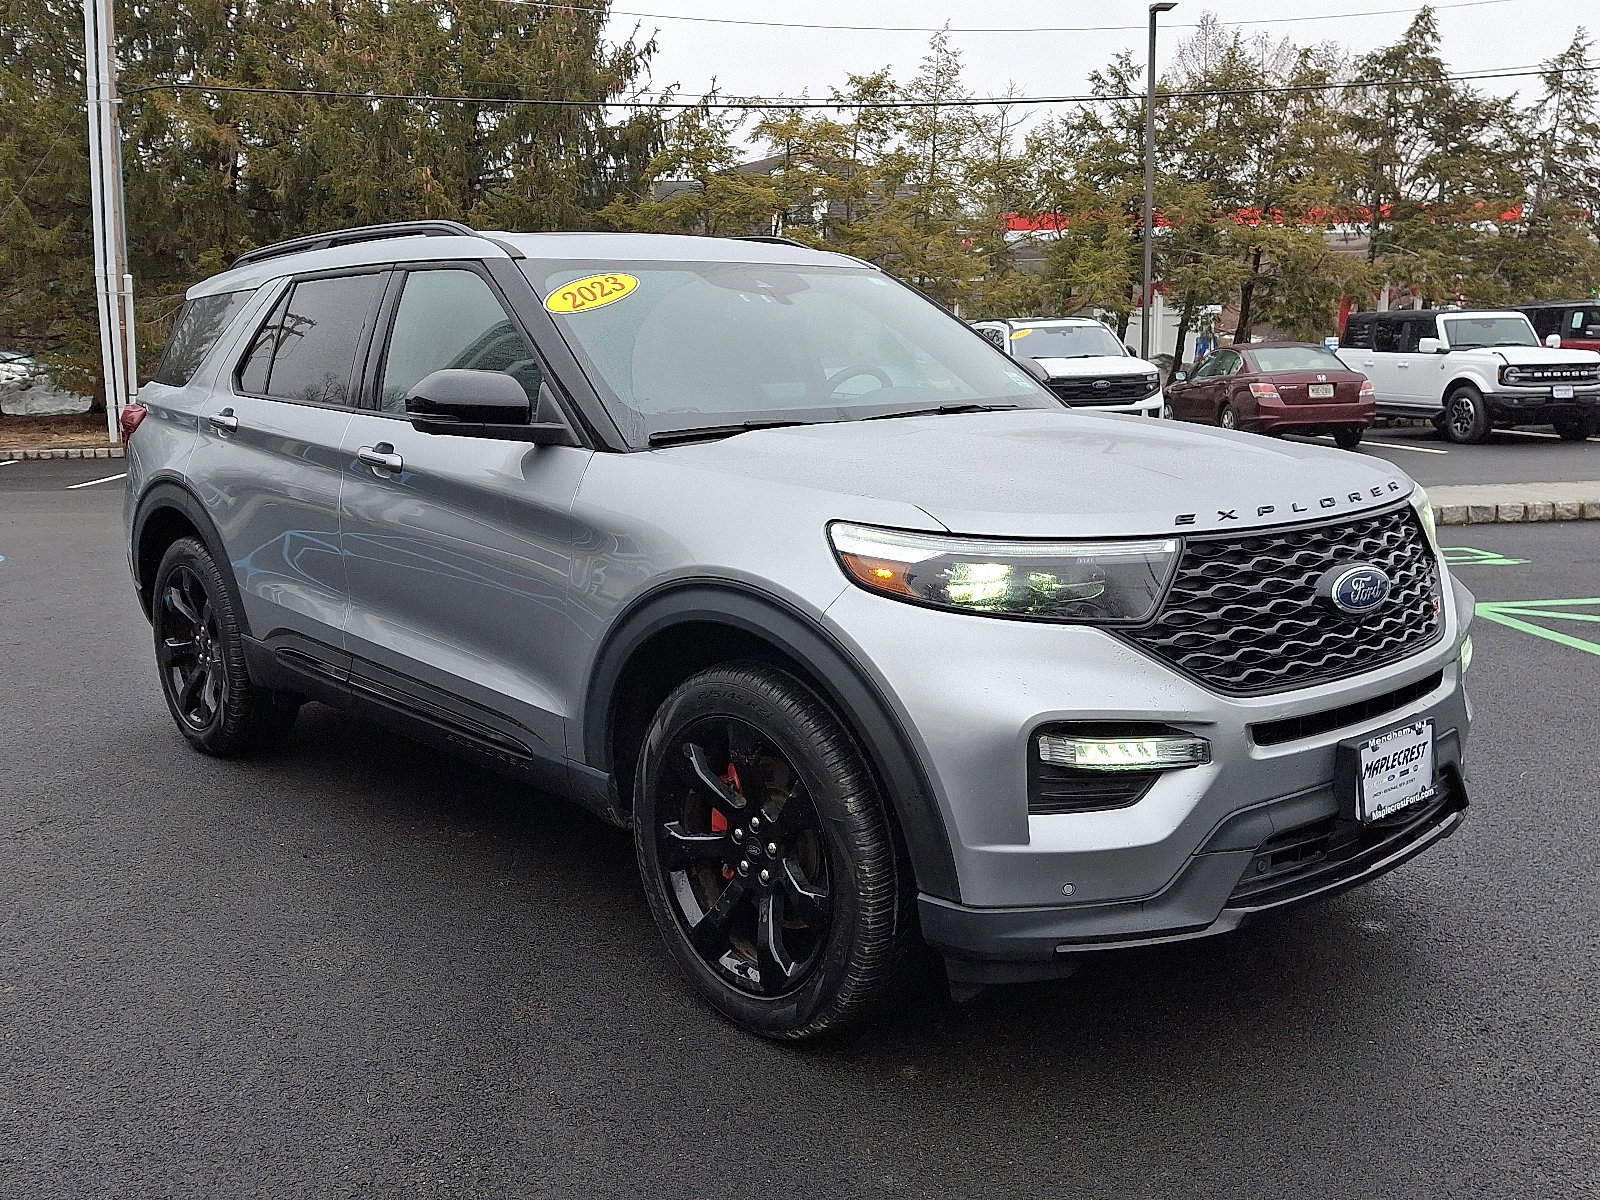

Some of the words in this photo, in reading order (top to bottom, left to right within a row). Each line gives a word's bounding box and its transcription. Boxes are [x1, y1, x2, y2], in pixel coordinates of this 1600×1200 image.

[562, 276, 626, 309] 2023
[1174, 481, 1401, 526] EXPLORER
[1351, 576, 1382, 604] Ford
[1415, 720, 1427, 730] NJ
[1362, 741, 1429, 780] MAPLECREST
[1371, 788, 1435, 820] MaplecrestFord.com
